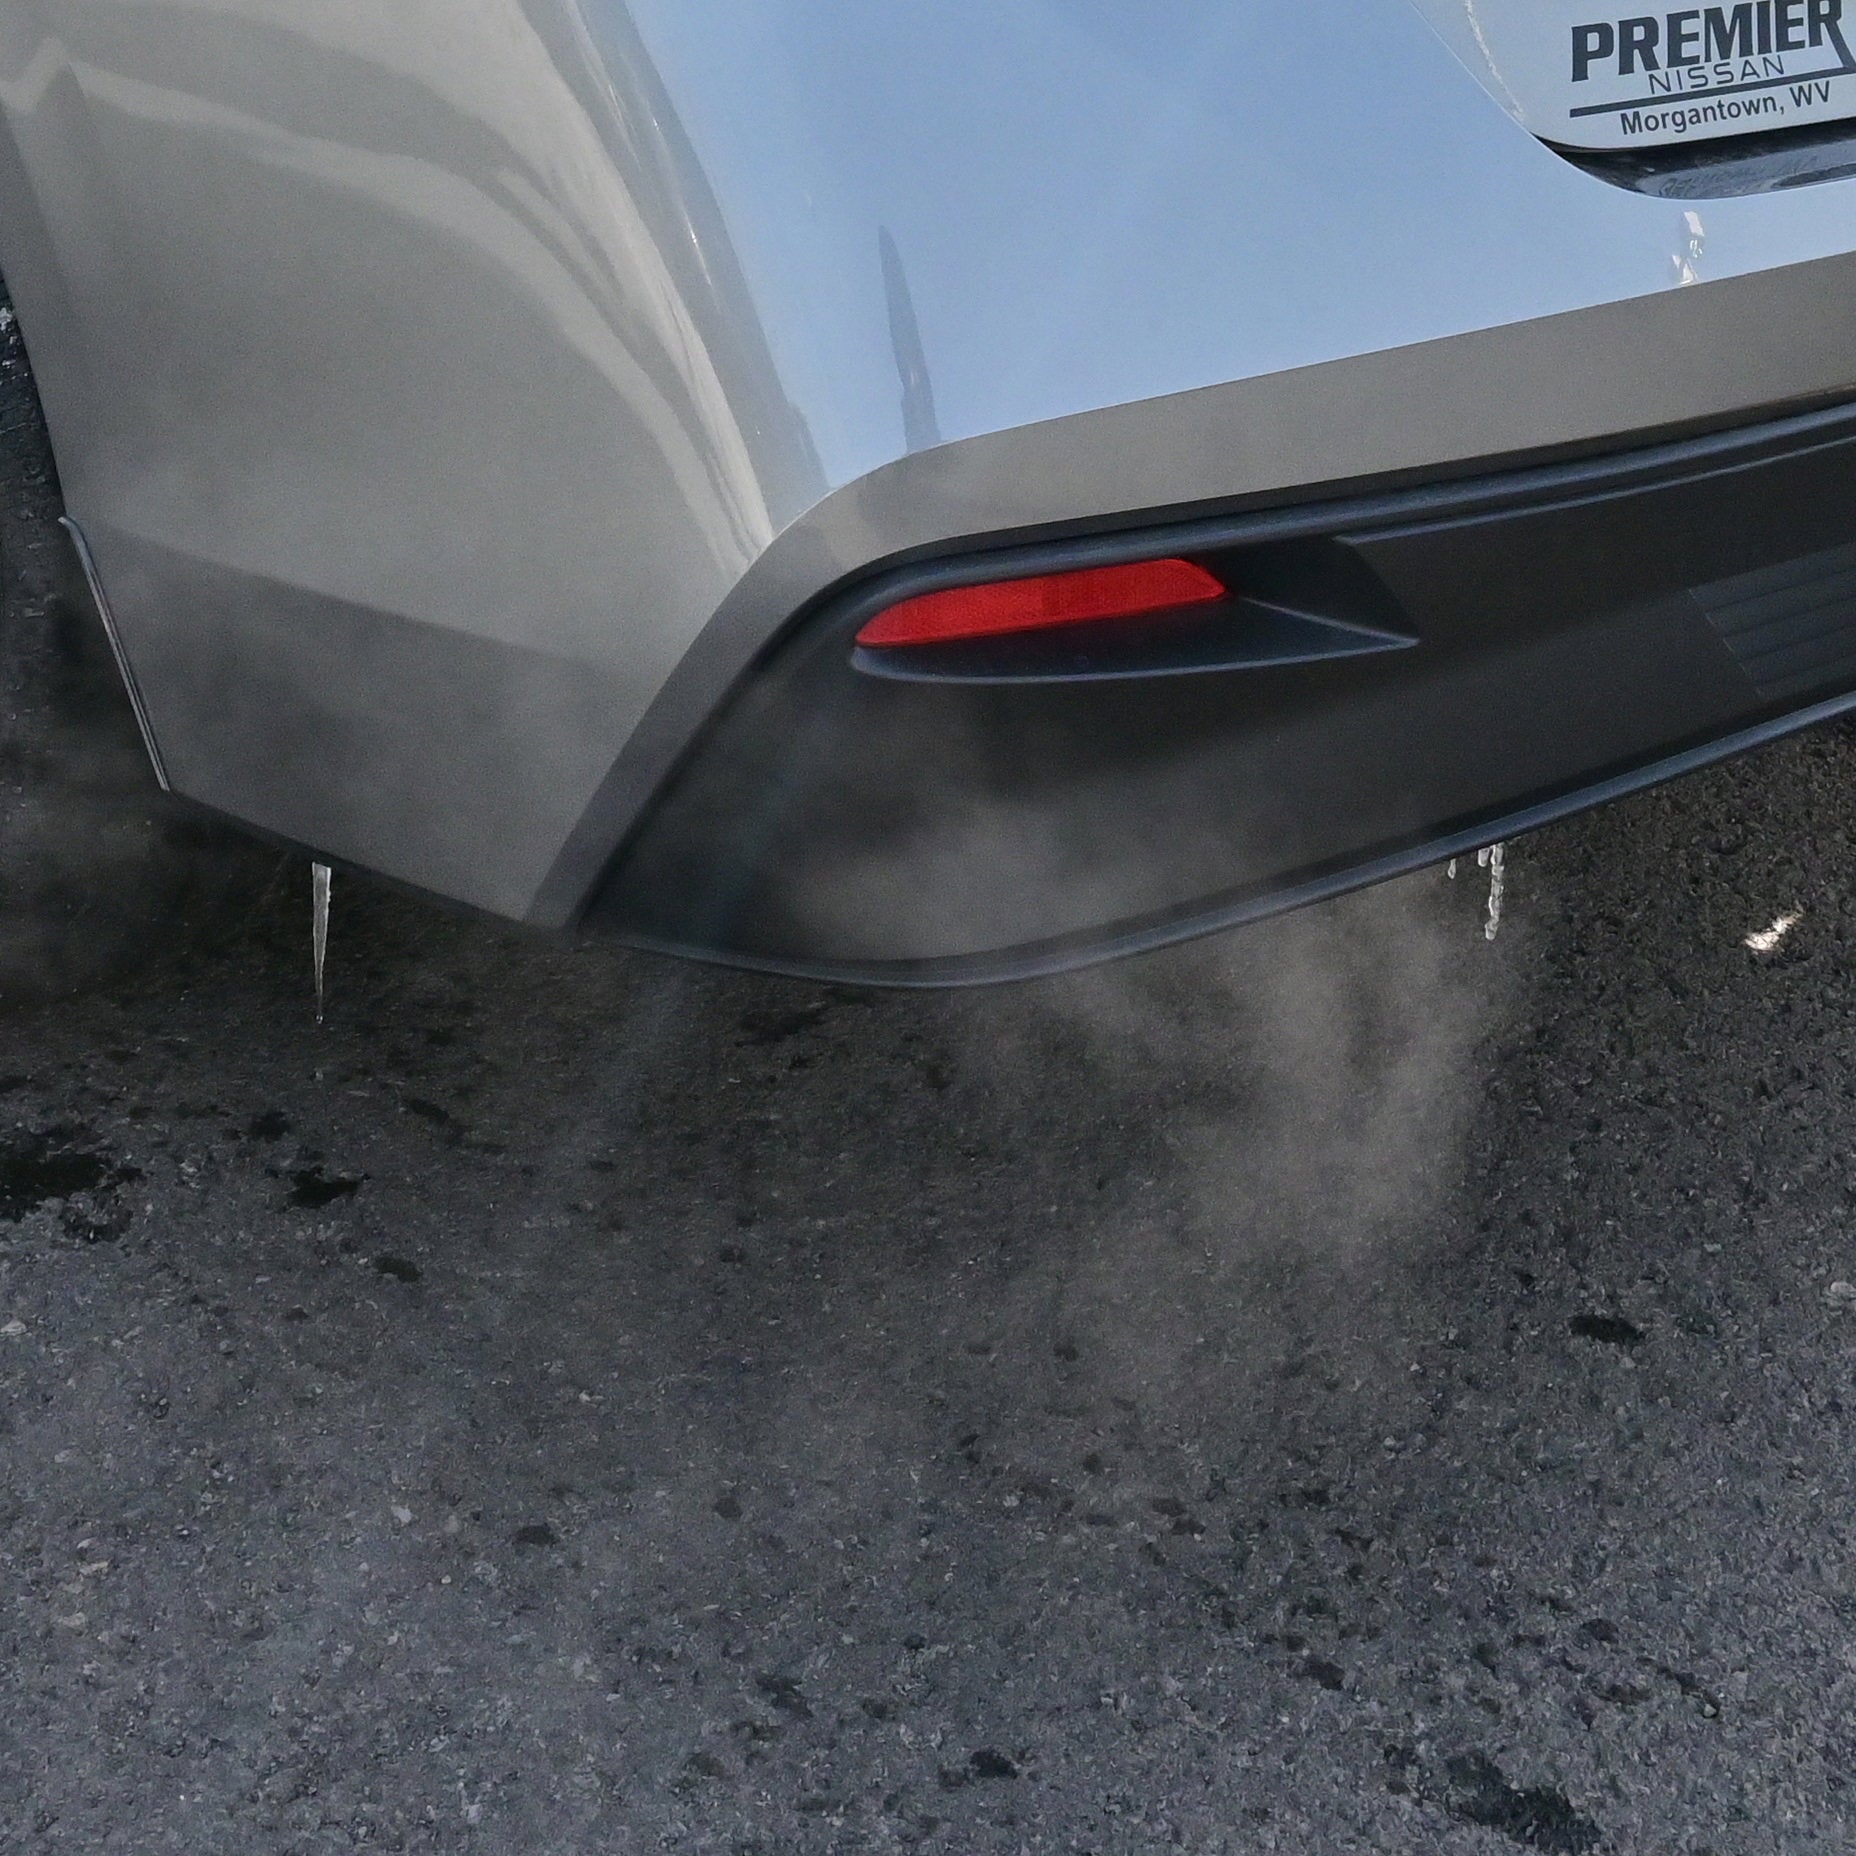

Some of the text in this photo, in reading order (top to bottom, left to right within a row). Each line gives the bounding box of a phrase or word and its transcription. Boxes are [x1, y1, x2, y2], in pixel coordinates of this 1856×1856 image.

[1649, 55, 1786, 95] NISSAN
[1620, 81, 1831, 135] Morgantown, WV
